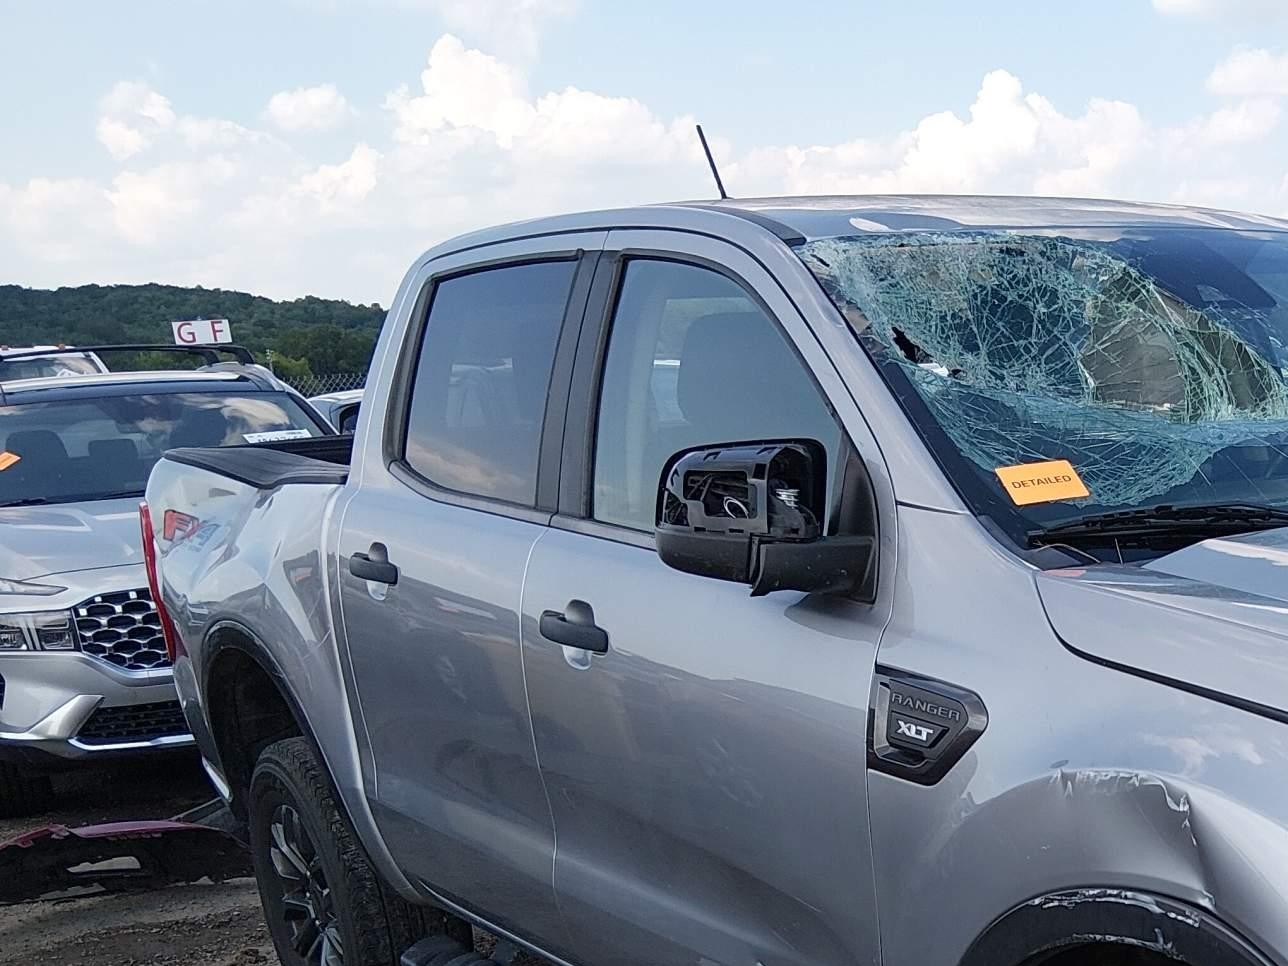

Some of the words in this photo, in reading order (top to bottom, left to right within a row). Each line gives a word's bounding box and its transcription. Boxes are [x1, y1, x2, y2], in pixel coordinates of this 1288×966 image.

[176, 322, 197, 344] G
[210, 320, 224, 342] F
[1011, 474, 1072, 489] DETAILED
[891, 692, 960, 721] RANGER
[896, 719, 934, 742] XLT
